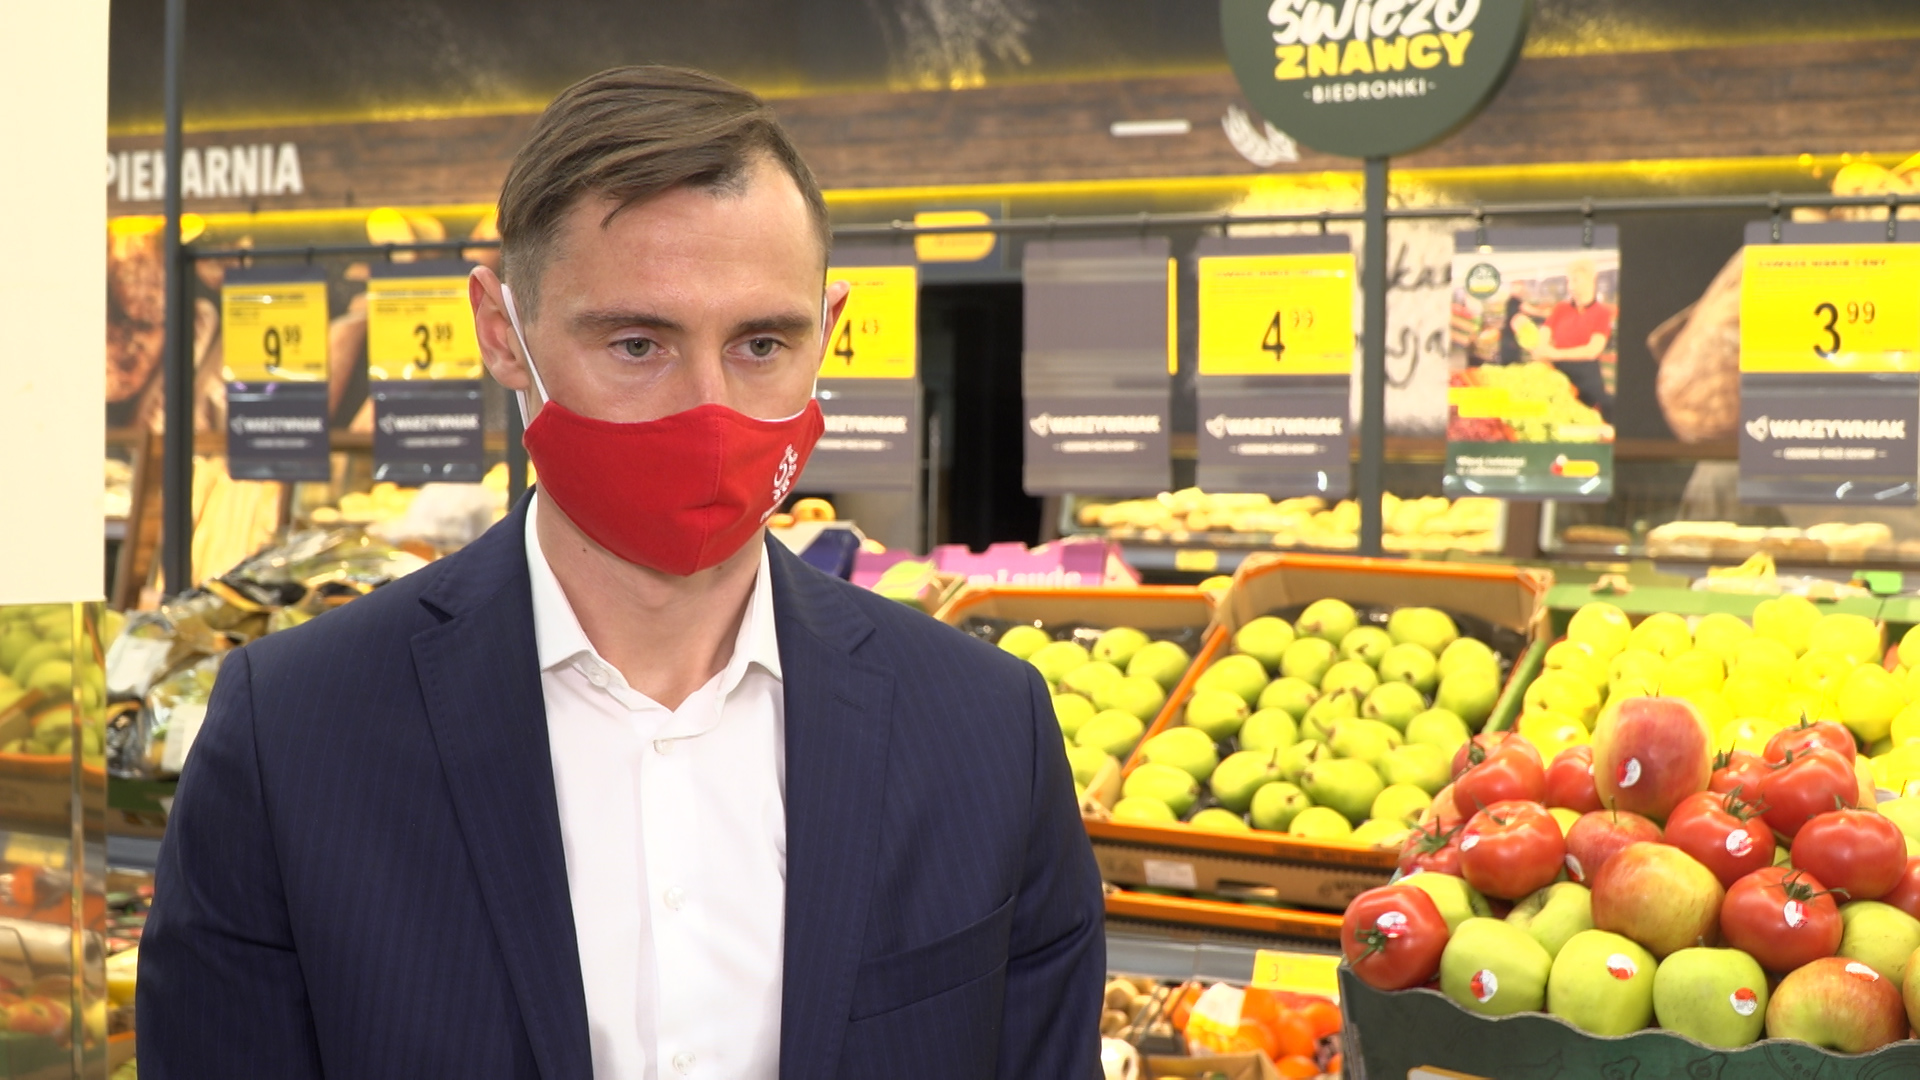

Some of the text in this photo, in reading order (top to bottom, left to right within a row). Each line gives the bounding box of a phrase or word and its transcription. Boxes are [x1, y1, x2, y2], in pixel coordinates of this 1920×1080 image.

[1275, 29, 1474, 80] ZNAWCY
[1312, 77, 1426, 104] BIEDRONKI
[263, 326, 282, 371] 9
[413, 323, 433, 370] 3
[833, 319, 854, 366] 4
[1261, 310, 1286, 362] 4
[1812, 301, 1876, 359] 3 99
[1769, 418, 1906, 440] WARZYWNIAK
